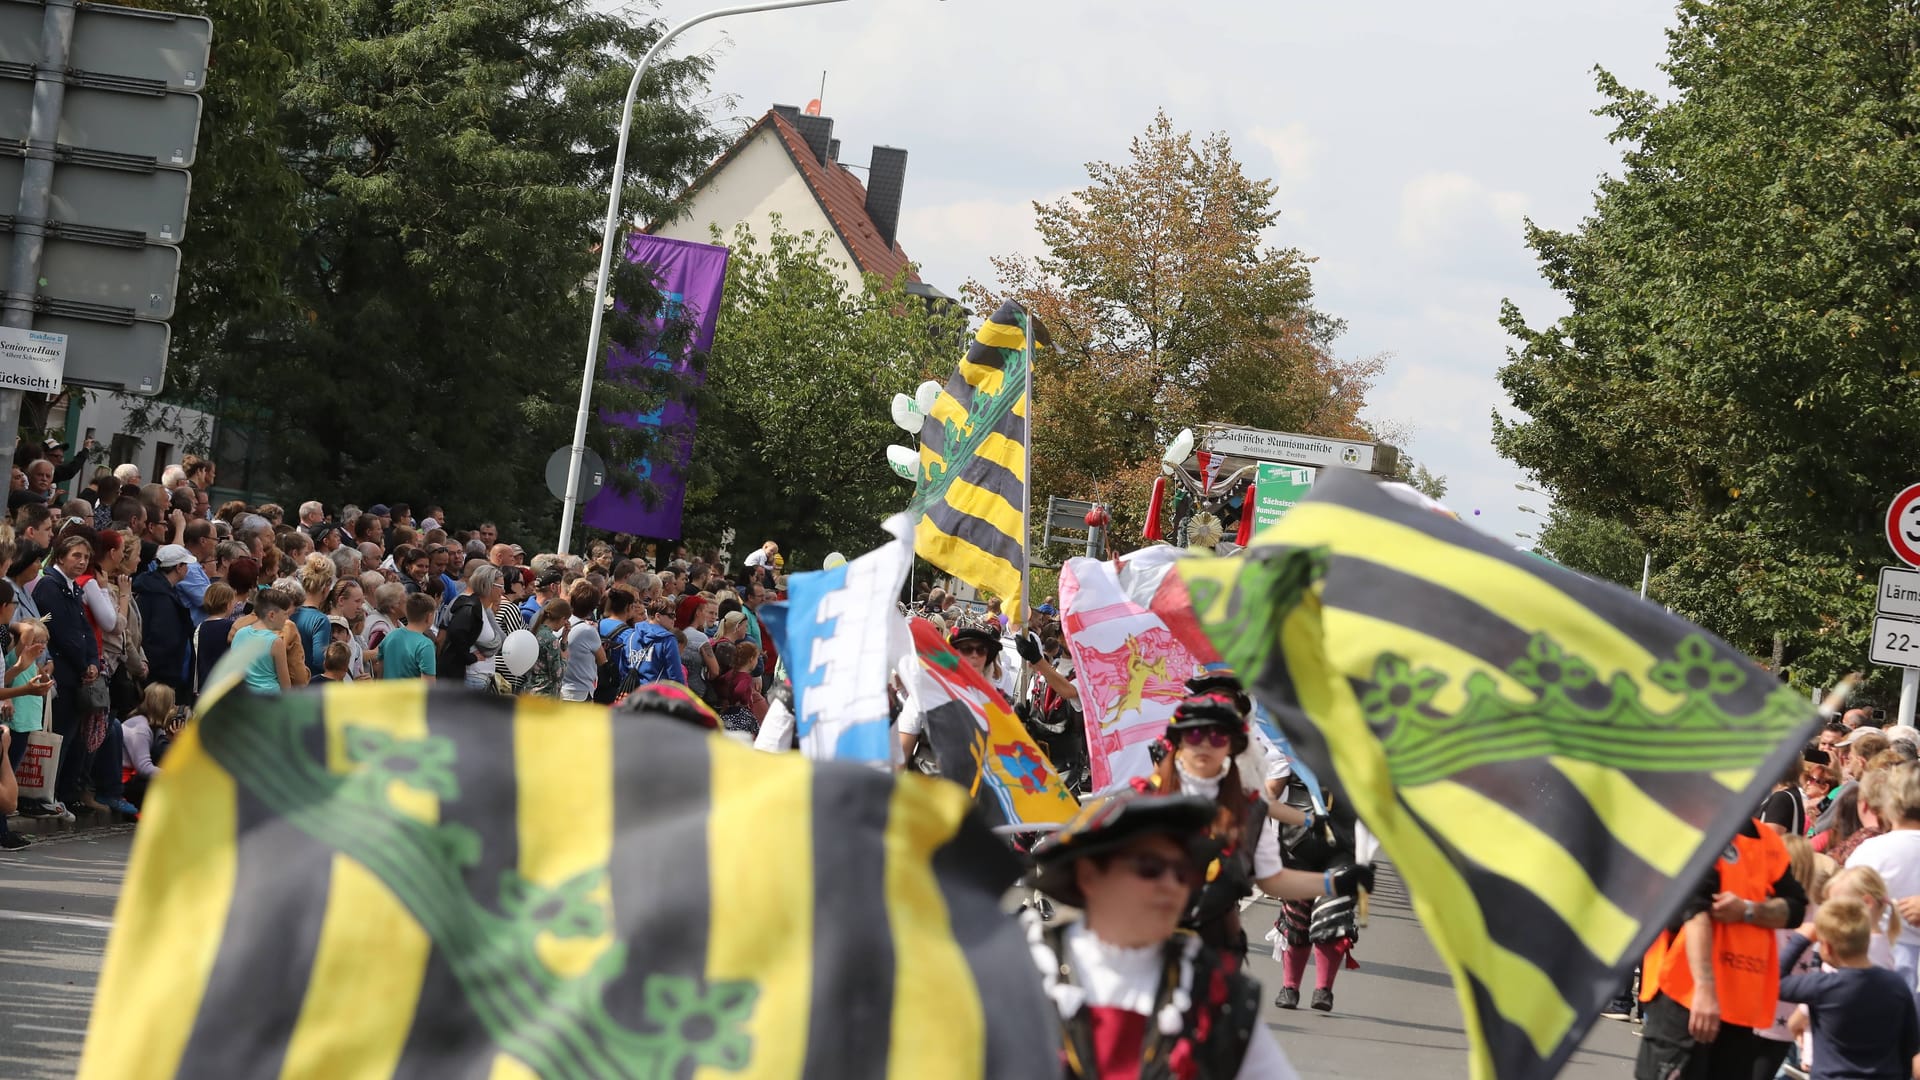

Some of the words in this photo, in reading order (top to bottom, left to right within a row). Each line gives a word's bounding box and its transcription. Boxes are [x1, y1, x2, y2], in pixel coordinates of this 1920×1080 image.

[0, 340, 61, 357] SeniorenHaus
[0, 371, 50, 389] ücksicht
[1267, 437, 1333, 455] Numismatische
[1299, 470, 1309, 483] 11
[1262, 496, 1297, 507] Sächsisch
[1906, 504, 1920, 543] 3
[1886, 583, 1920, 602] Lärms
[1886, 631, 1920, 652] 22-
